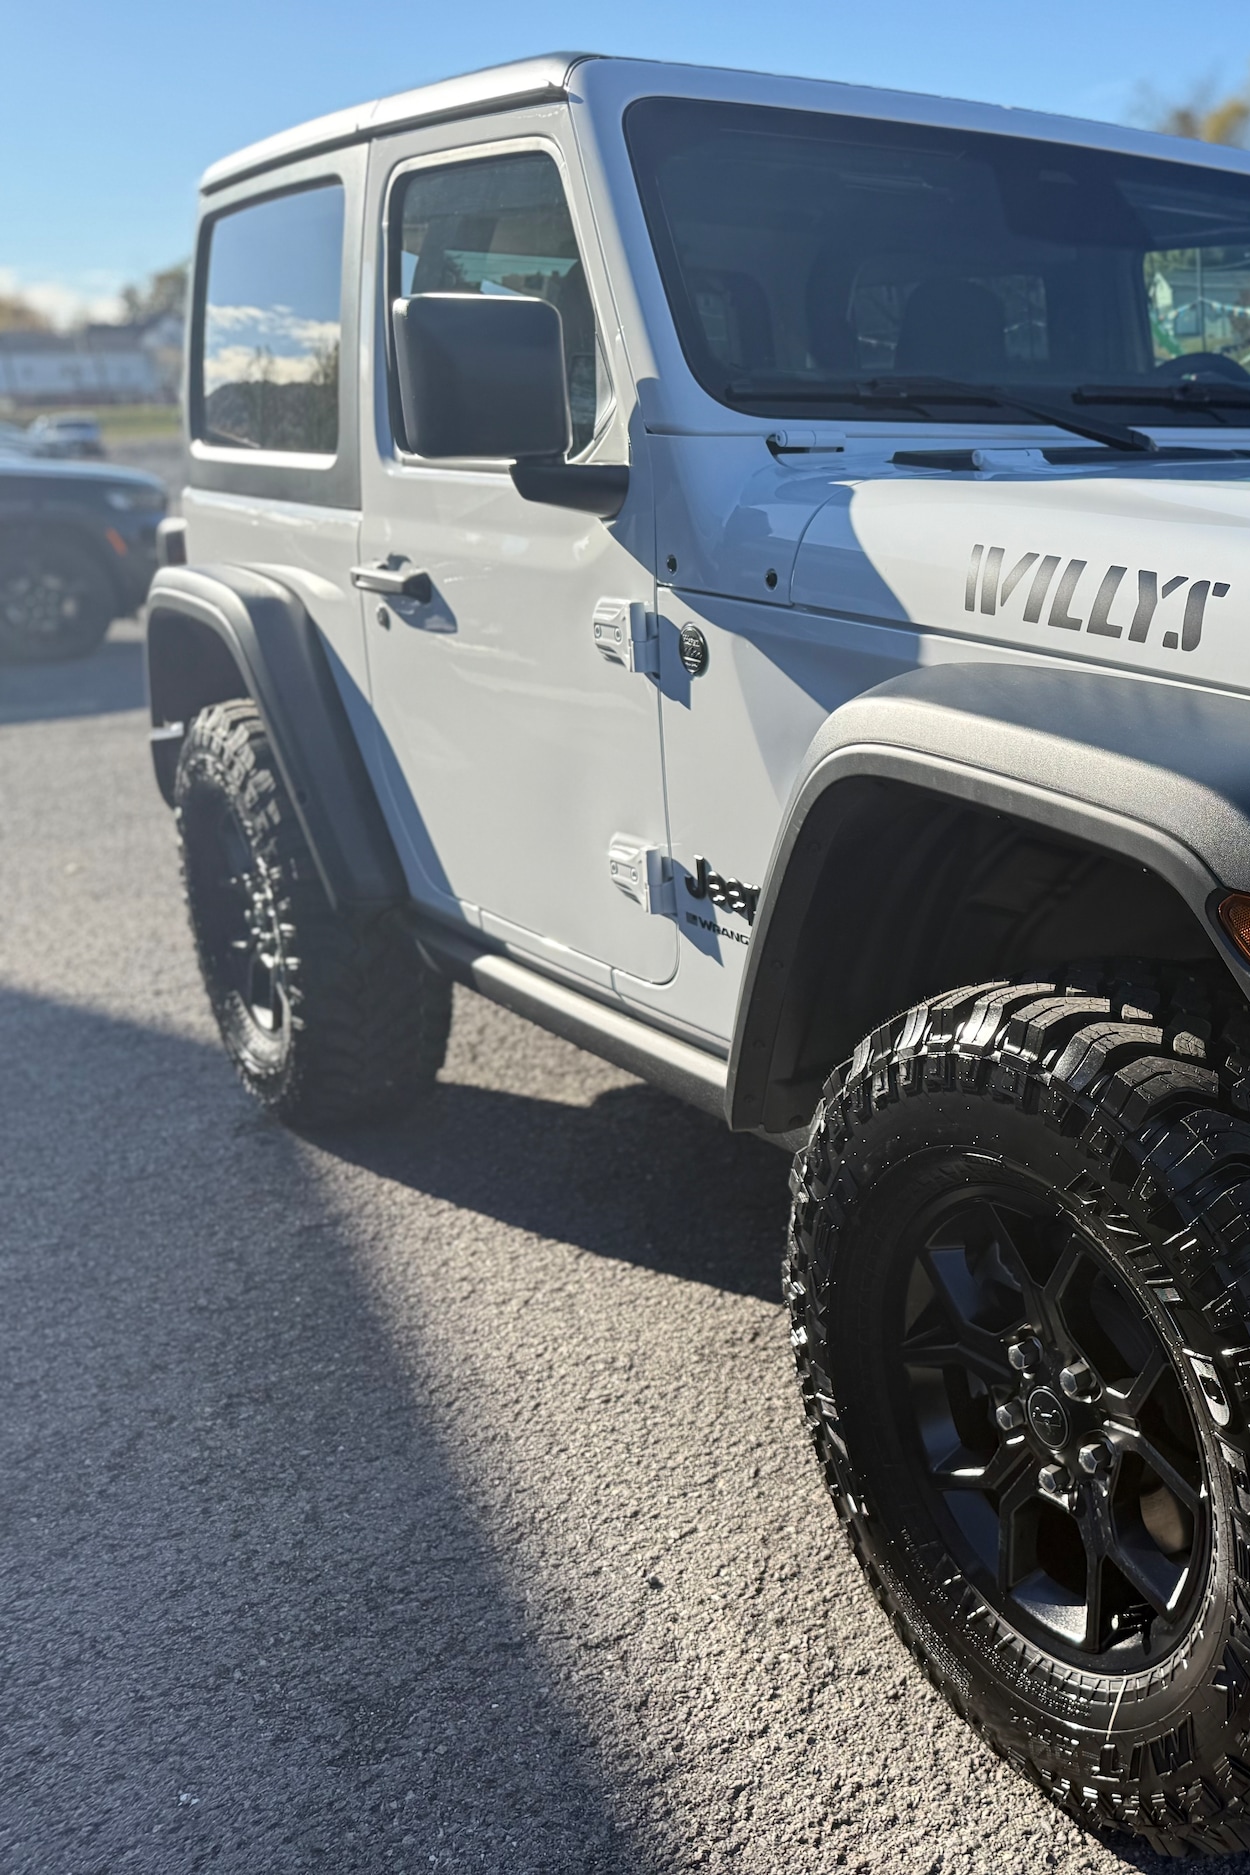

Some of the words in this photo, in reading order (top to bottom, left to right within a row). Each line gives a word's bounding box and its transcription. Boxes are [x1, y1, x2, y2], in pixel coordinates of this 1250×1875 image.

[964, 543, 1231, 652] WILLYS
[684, 854, 761, 927] Jeep
[1090, 1710, 1198, 1783] M/T
